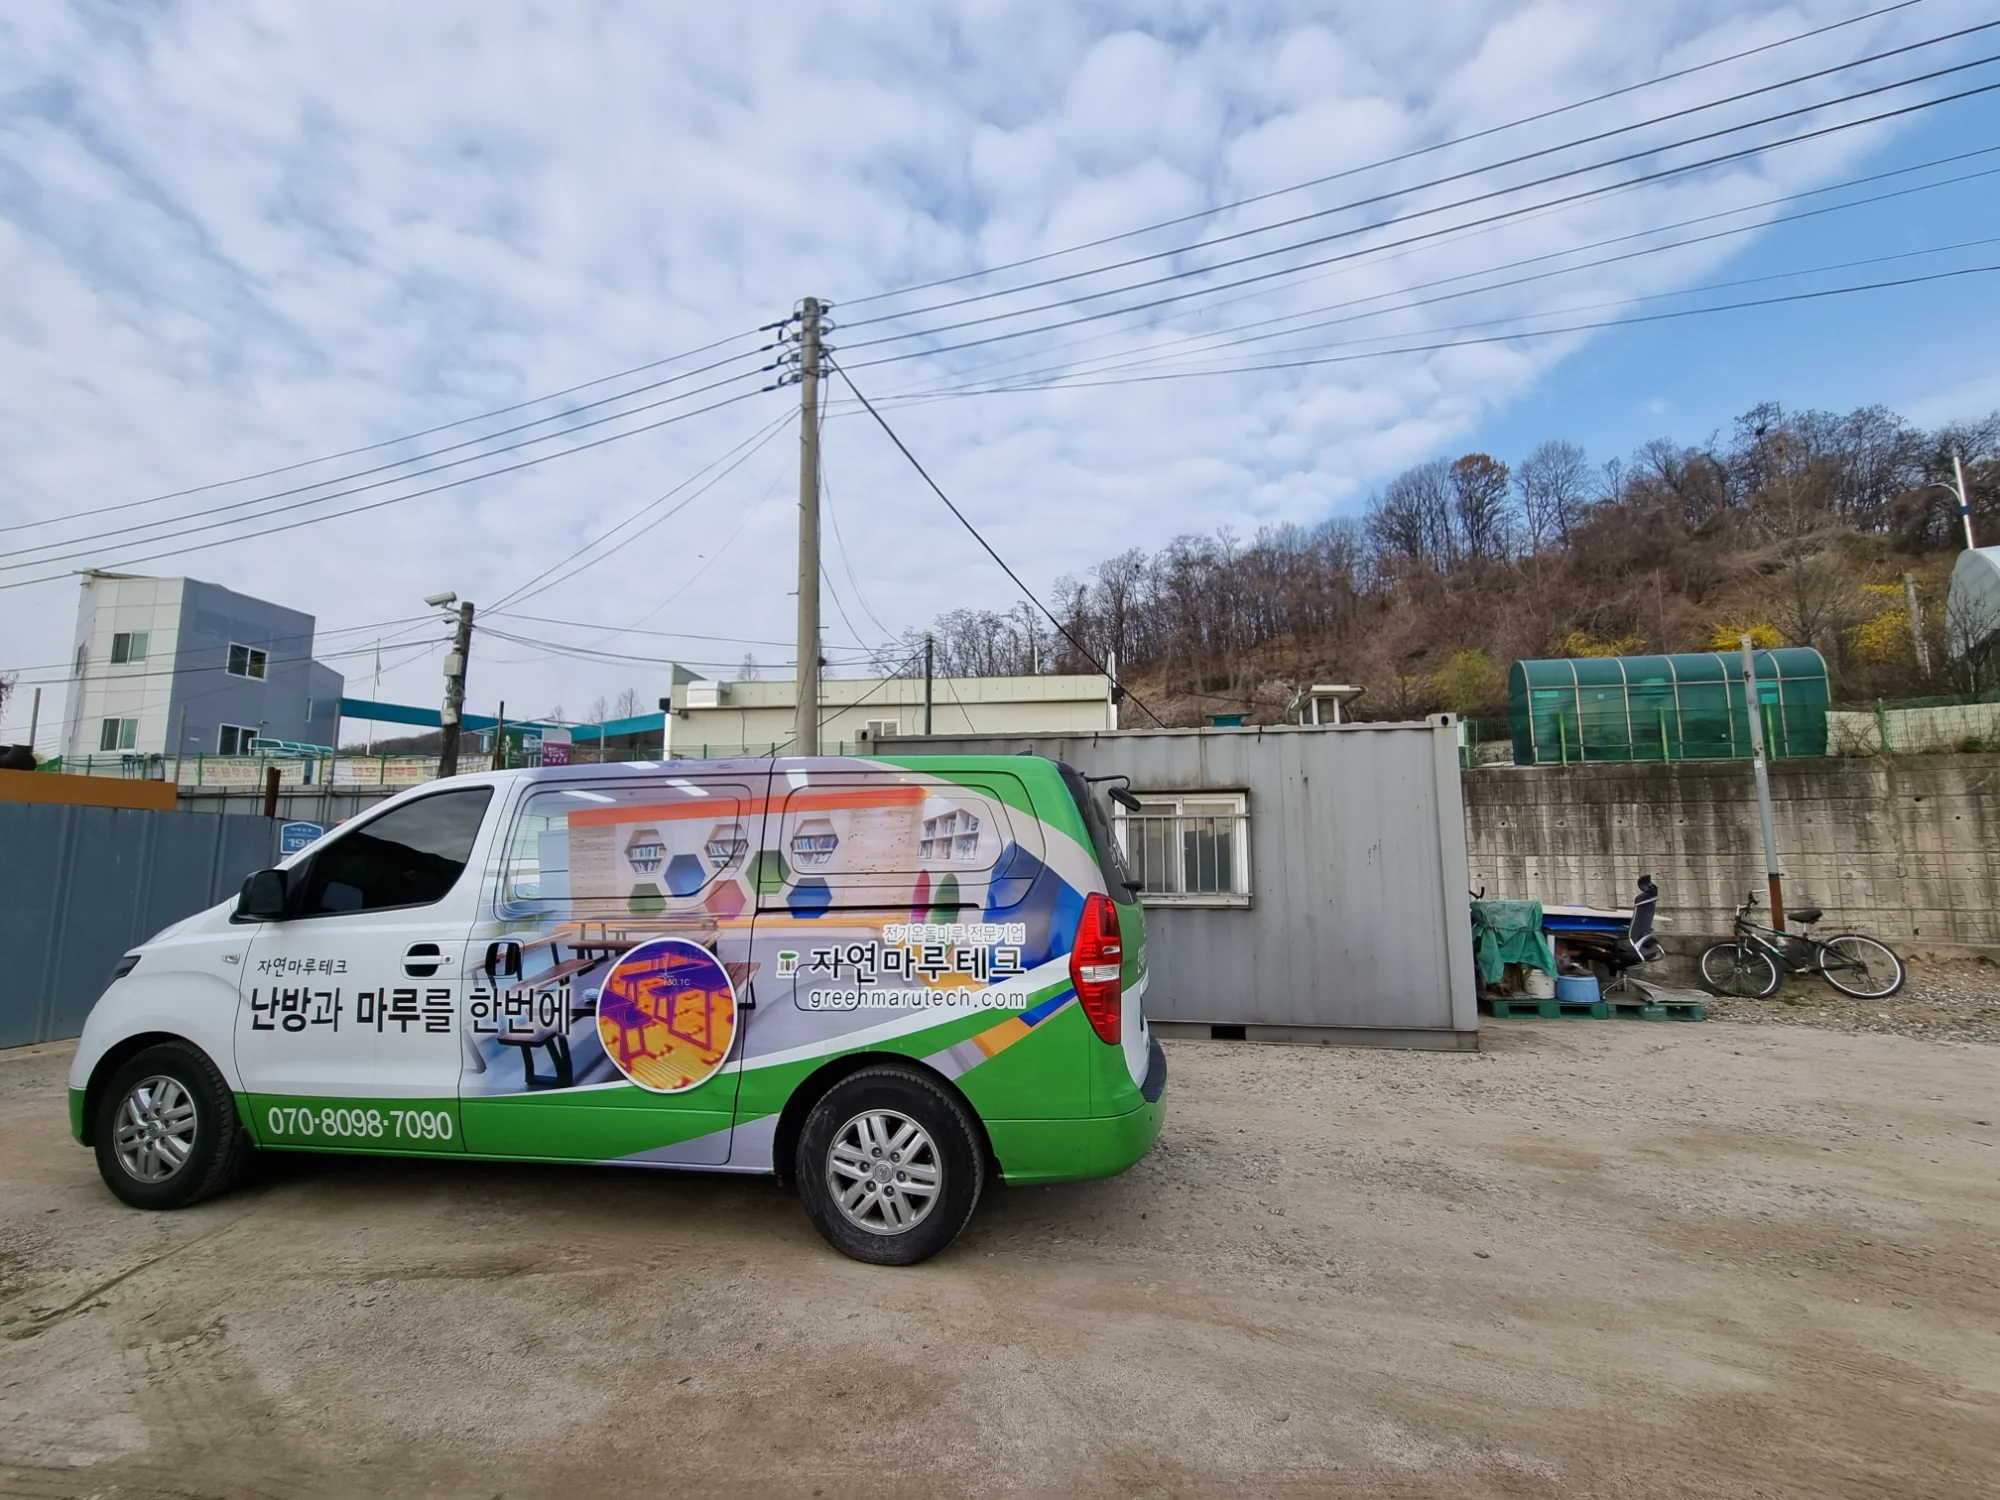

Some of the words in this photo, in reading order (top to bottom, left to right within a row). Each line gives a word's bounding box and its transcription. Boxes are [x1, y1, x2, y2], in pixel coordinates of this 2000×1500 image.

[885, 925, 965, 943] 전기온돌마루
[970, 925, 1024, 943] 전문기업
[257, 957, 347, 977] 자연마루테크
[811, 942, 1025, 983] 자연마루테크
[811, 988, 1024, 1008] greenmarutech.com
[251, 986, 343, 1033] 난방과
[356, 987, 455, 1034] 마루를
[469, 987, 570, 1035] 한번에
